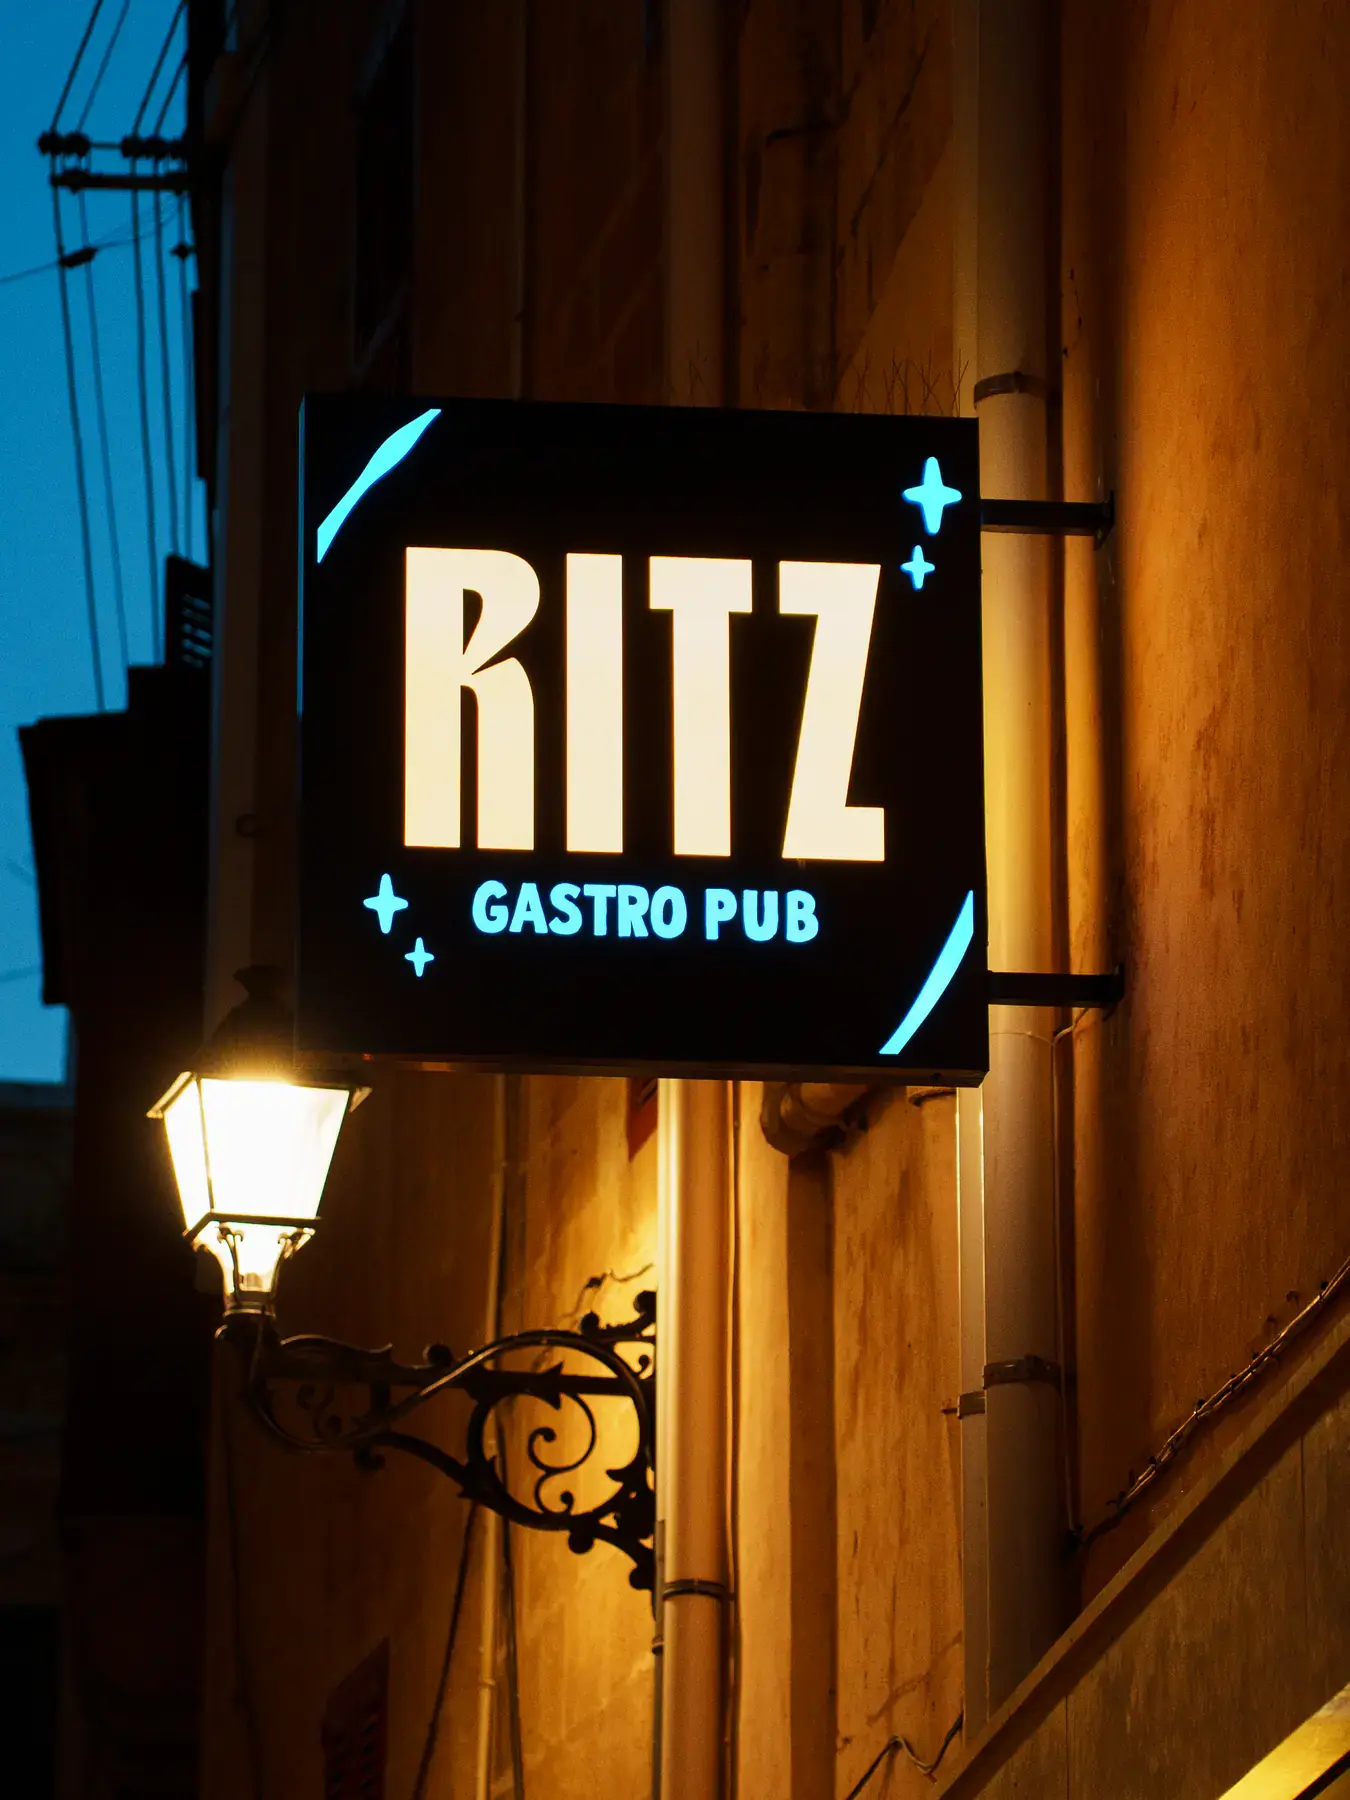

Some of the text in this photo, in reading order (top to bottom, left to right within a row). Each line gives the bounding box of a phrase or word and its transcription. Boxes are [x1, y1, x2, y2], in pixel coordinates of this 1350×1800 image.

[404, 546, 885, 862] RITZ
[471, 880, 820, 943] GASTRO PUB
